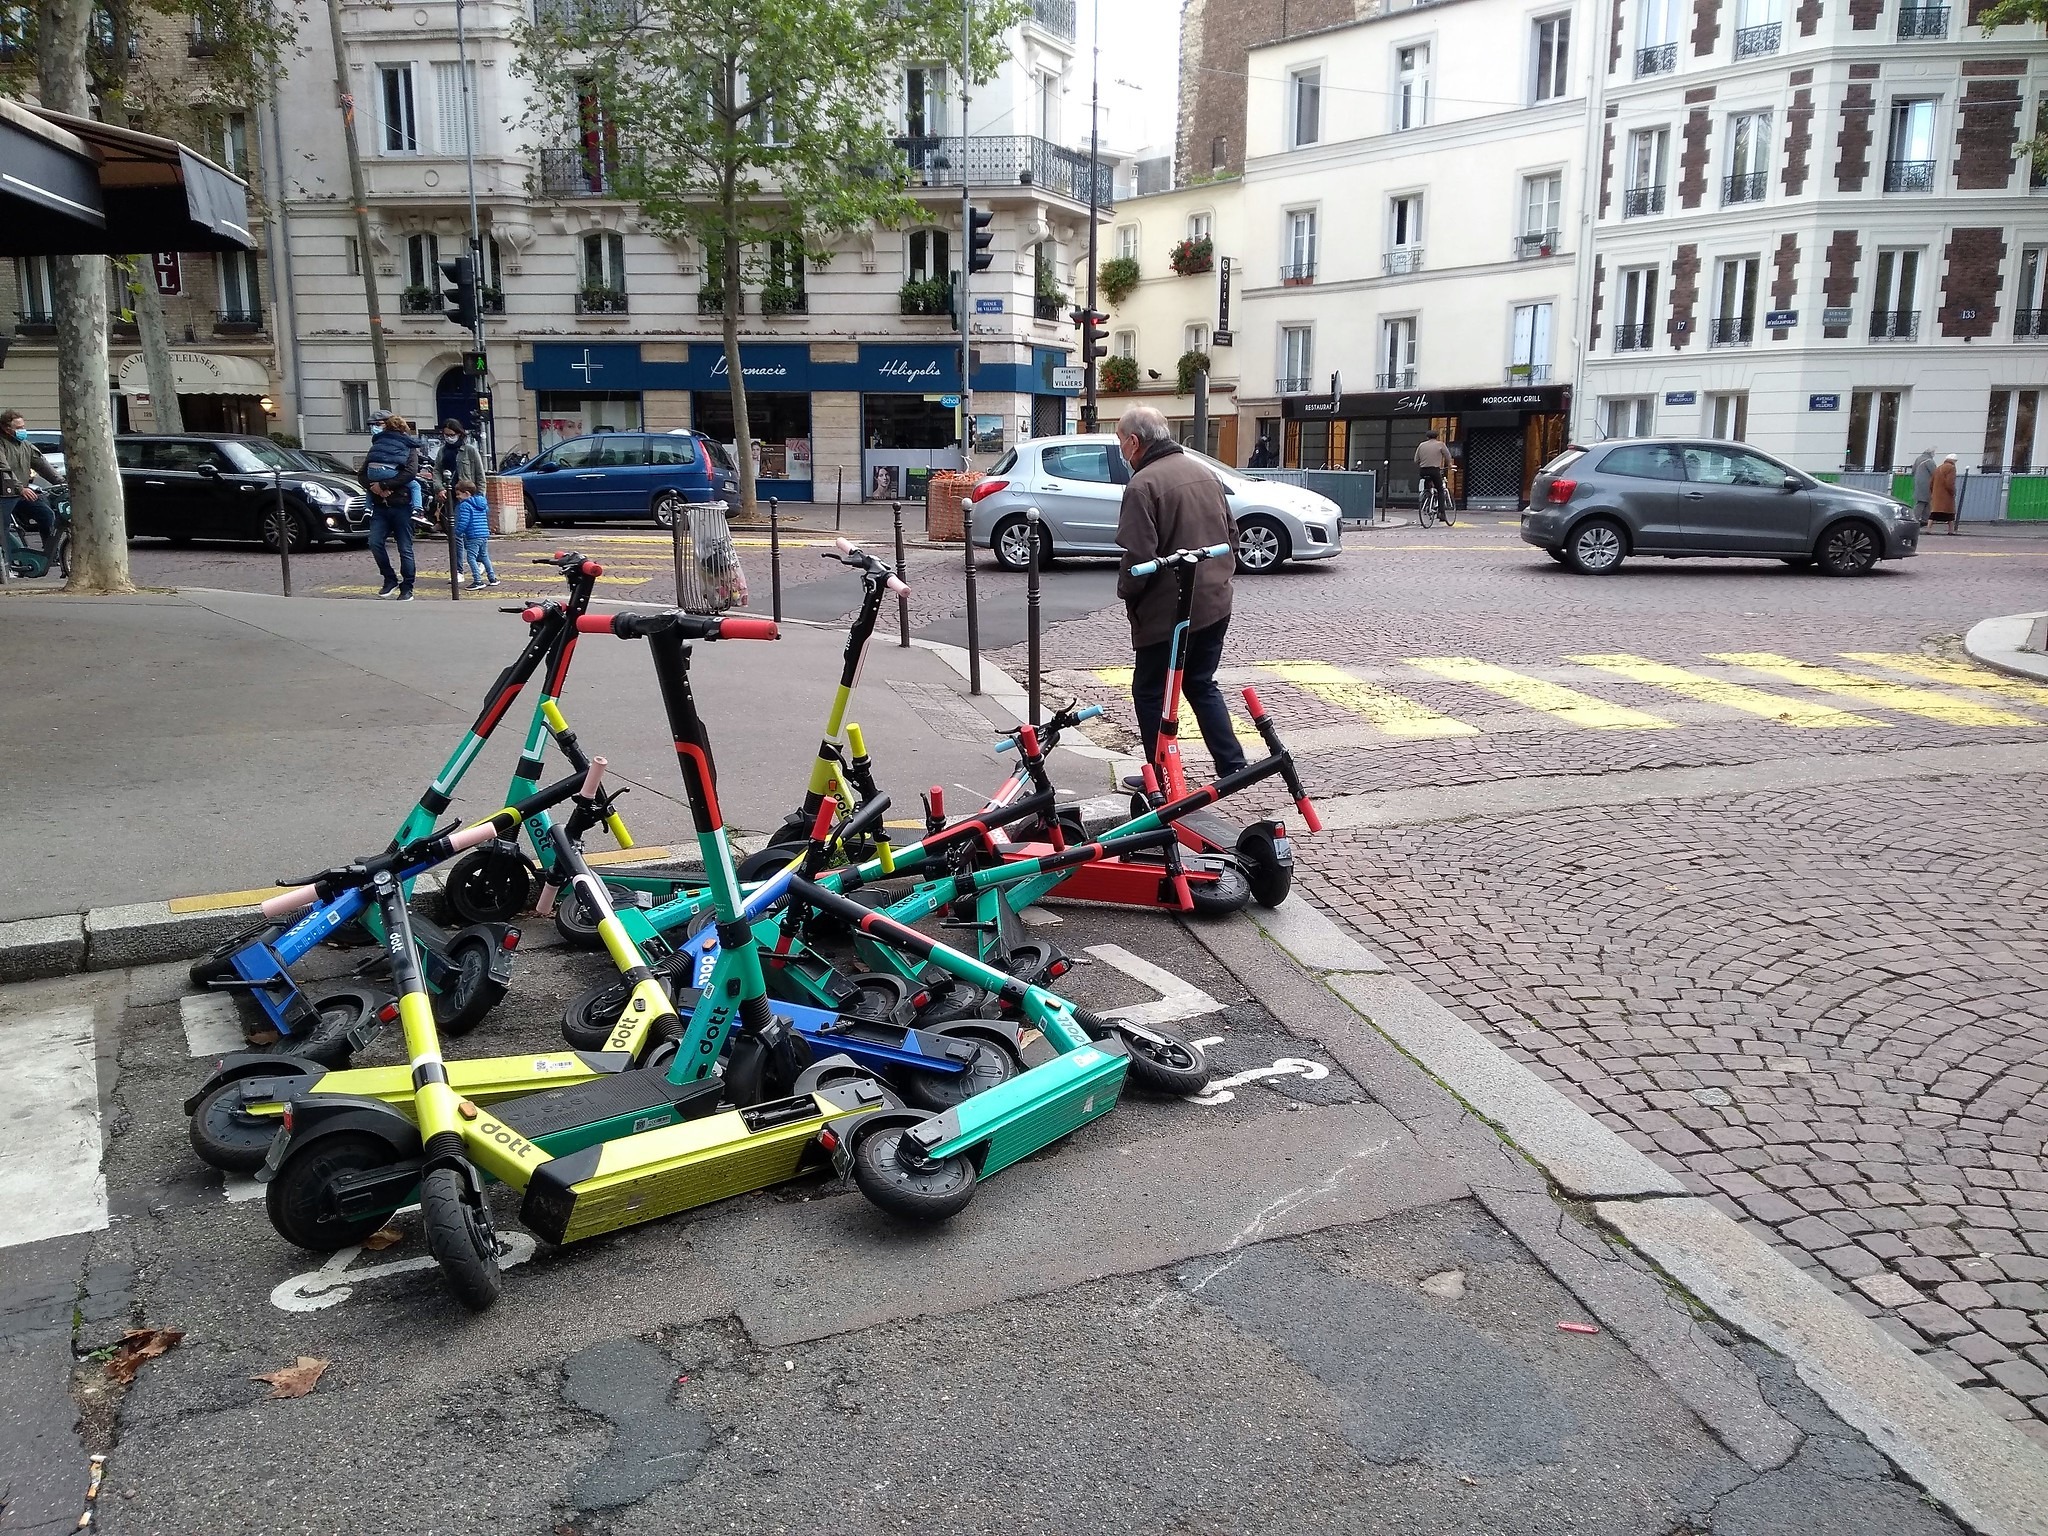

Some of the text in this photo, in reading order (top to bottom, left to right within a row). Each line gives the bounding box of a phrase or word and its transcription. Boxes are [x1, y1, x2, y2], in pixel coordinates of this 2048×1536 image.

[1677, 321, 1686, 330] 17
[1962, 310, 1976, 319] 133
[710, 355, 941, 383] Prmacie Heliopolis
[1482, 395, 1541, 404] MOROCCAN GRILL
[529, 818, 552, 852] dott
[389, 932, 405, 954] dott
[698, 955, 717, 986] dott
[612, 1018, 640, 1049] dott
[699, 1005, 730, 1056] dott
[1057, 1016, 1086, 1043] dott
[480, 1121, 532, 1159] dott
